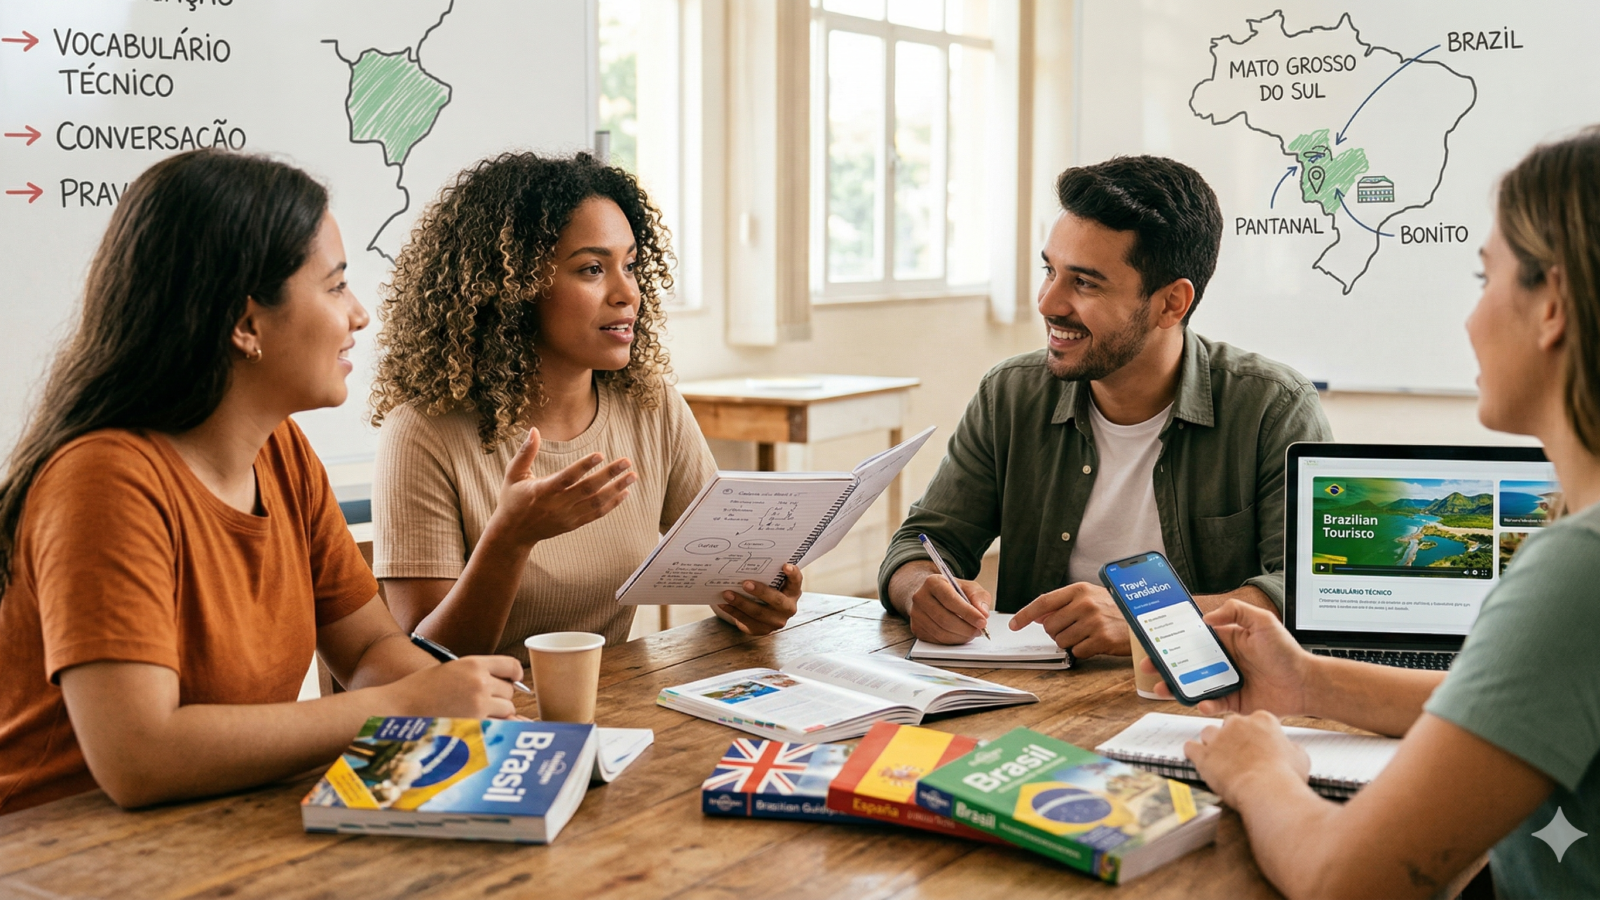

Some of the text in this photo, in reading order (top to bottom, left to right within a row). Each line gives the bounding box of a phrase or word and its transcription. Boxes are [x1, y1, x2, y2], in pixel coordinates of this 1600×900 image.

[53, 27, 231, 63] VOCABULÁRIO
[1229, 54, 1357, 79] MATO GROSSO
[58, 62, 174, 97] TÉCNICO
[1260, 82, 1326, 101] DO SUL
[1235, 217, 1324, 235] PANTANAL
[1400, 222, 1469, 244] BONITO
[1323, 514, 1378, 526] Brazilian
[1322, 527, 1375, 539] Tourisco
[1119, 577, 1148, 592] Travel
[1125, 582, 1172, 601] translation
[1319, 587, 1392, 596] VOCABULÁRIO TÉCNICO
[482, 731, 556, 803] Brasil
[962, 744, 1058, 793] Brasil
[852, 797, 899, 818] España
[955, 801, 996, 829] Brasil
